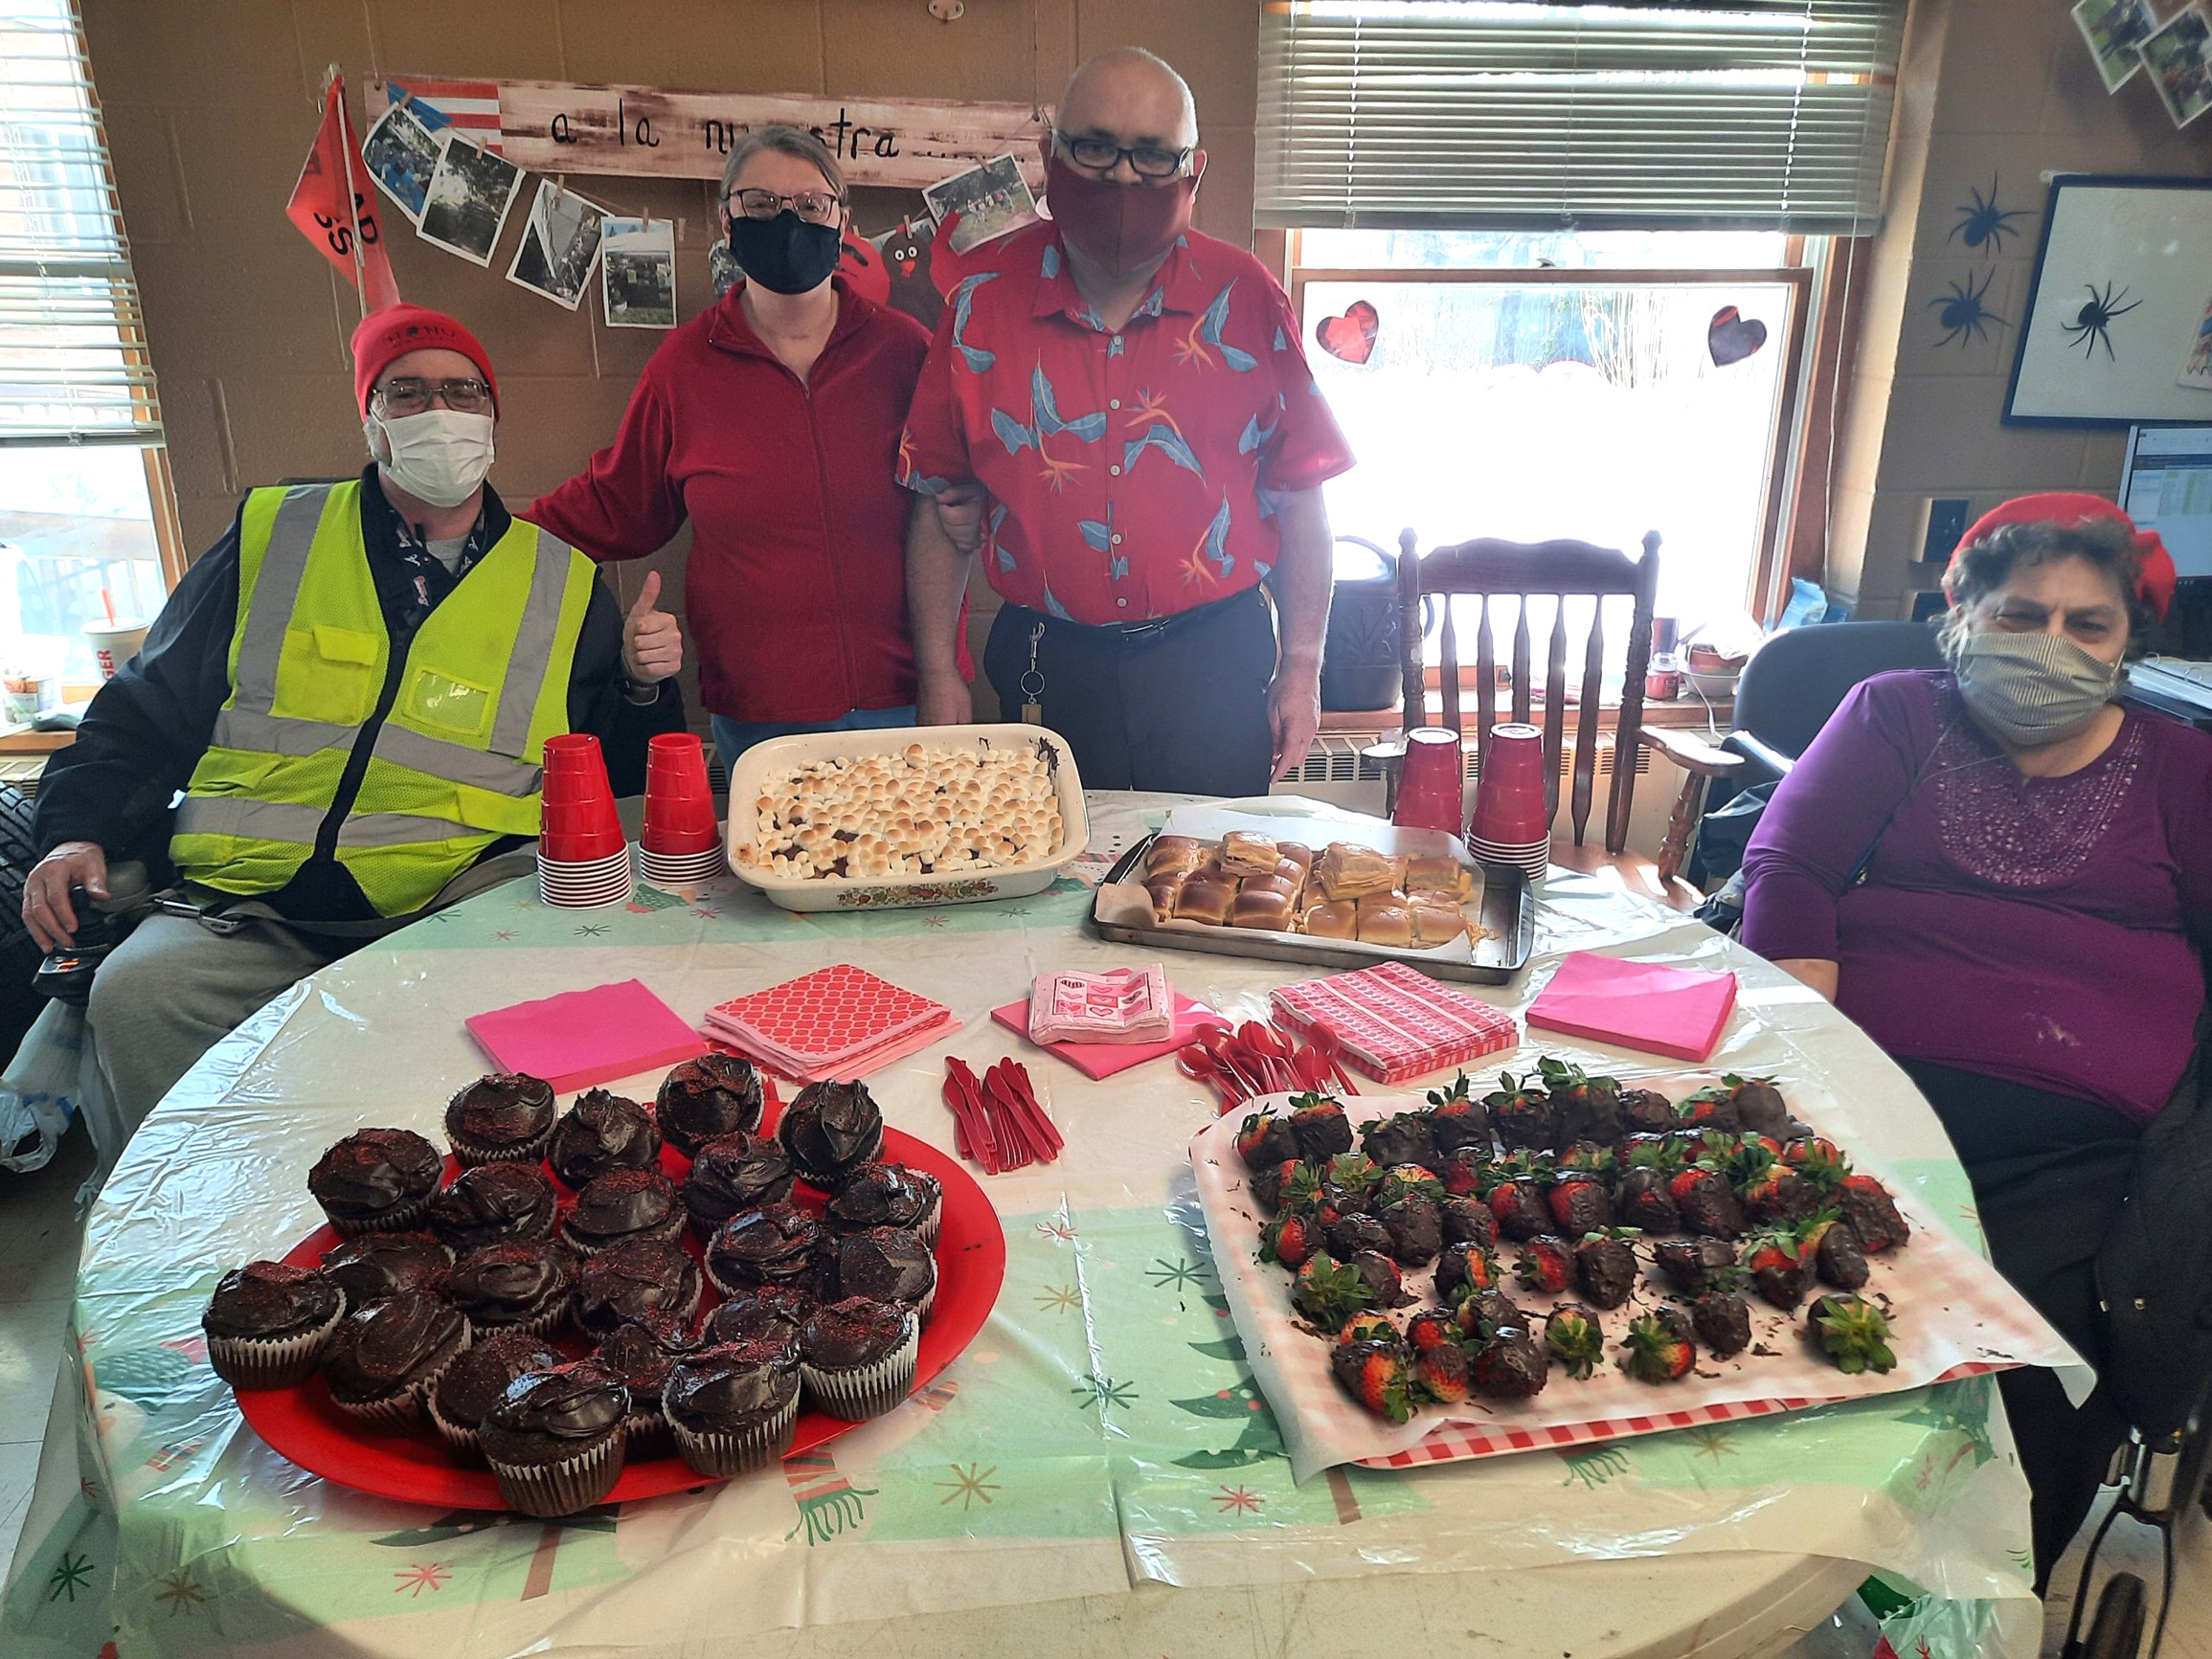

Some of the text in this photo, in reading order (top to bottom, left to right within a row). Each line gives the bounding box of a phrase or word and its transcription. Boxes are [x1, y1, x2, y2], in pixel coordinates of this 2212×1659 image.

[551, 97, 900, 160] a la nustra
